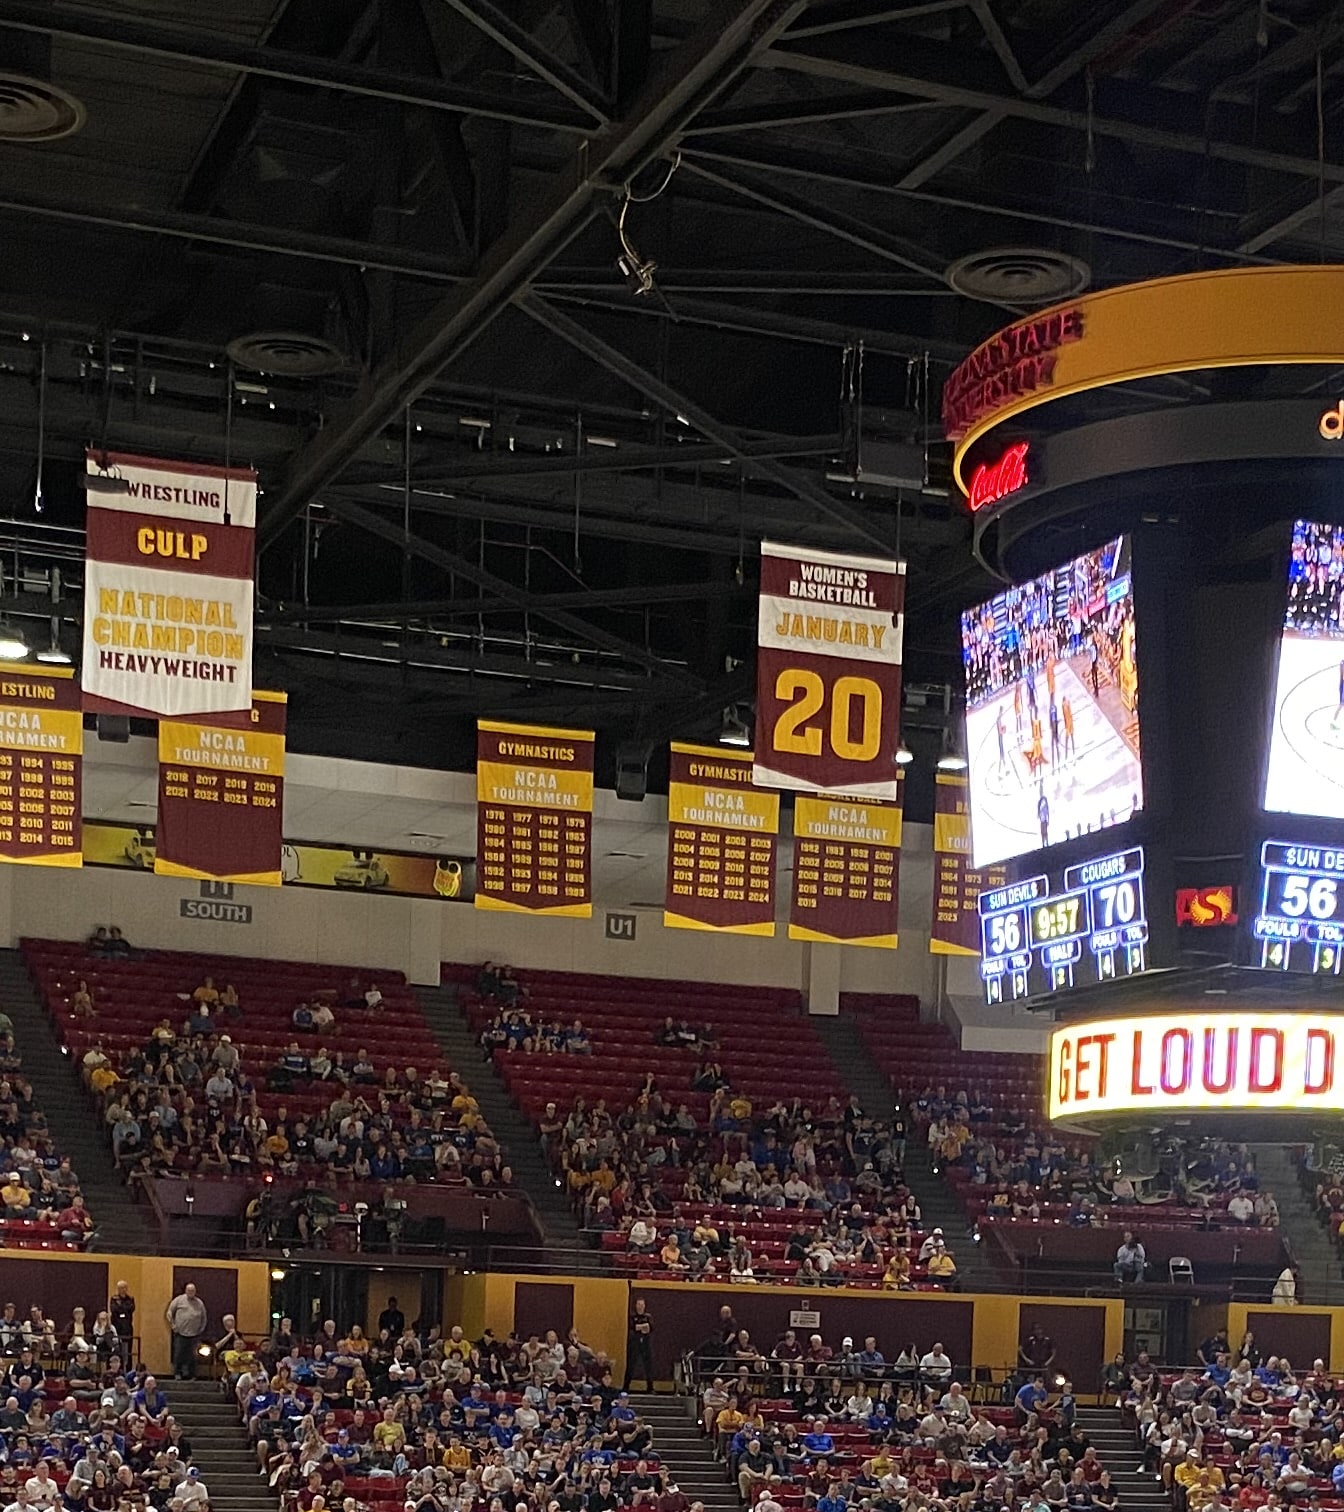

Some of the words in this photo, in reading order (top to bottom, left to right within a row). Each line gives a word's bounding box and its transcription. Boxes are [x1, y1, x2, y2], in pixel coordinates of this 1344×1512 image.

[128, 482, 220, 508] WRESTLING
[138, 528, 208, 560] CULP
[801, 564, 868, 587] WOMEN'S
[790, 581, 876, 607] BASKETBALL
[99, 588, 237, 629] NATIONAL
[93, 617, 243, 660] CHAMPION
[776, 612, 886, 648] JANUARY
[100, 651, 237, 683] HEAVYWEIGHT
[774, 669, 882, 761] 20
[200, 732, 245, 752] NCAA
[499, 742, 575, 761] GYMNASTICS
[176, 748, 269, 770] TOURNAMENT
[196, 774, 217, 786] 2017
[515, 771, 556, 788] NCAA
[690, 764, 753, 782] GYMNASTIC
[20, 788, 44, 799] 2002
[166, 786, 188, 797] 2021
[493, 787, 579, 806] TOURNAMENT
[705, 792, 744, 810] NCAA
[51, 805, 75, 816] 2007
[683, 808, 765, 826] TOURNAMENT
[829, 807, 867, 824] NCAA
[20, 818, 43, 828] 2010
[52, 820, 72, 831] 2011
[808, 822, 888, 840] TOURNAMENT
[20, 833, 43, 844] 2014
[1286, 848, 1319, 868] SUN
[1082, 856, 1126, 883] COUGARS
[989, 895, 1006, 909] SUN
[1008, 882, 1038, 905] DEVILS
[1100, 883, 1135, 926] 70
[1280, 876, 1338, 919] 56
[186, 903, 247, 921] SOUTH
[1038, 899, 1079, 939] 9:57
[610, 919, 632, 935] U1
[992, 914, 1020, 953] 56
[1256, 920, 1300, 936] FOULS
[1318, 923, 1343, 940] TOL
[1269, 944, 1283, 965] 4
[1321, 949, 1334, 969] 3
[1059, 1033, 1116, 1105] GET
[1131, 1027, 1285, 1095] LOUD
[1304, 1028, 1335, 1094] D
